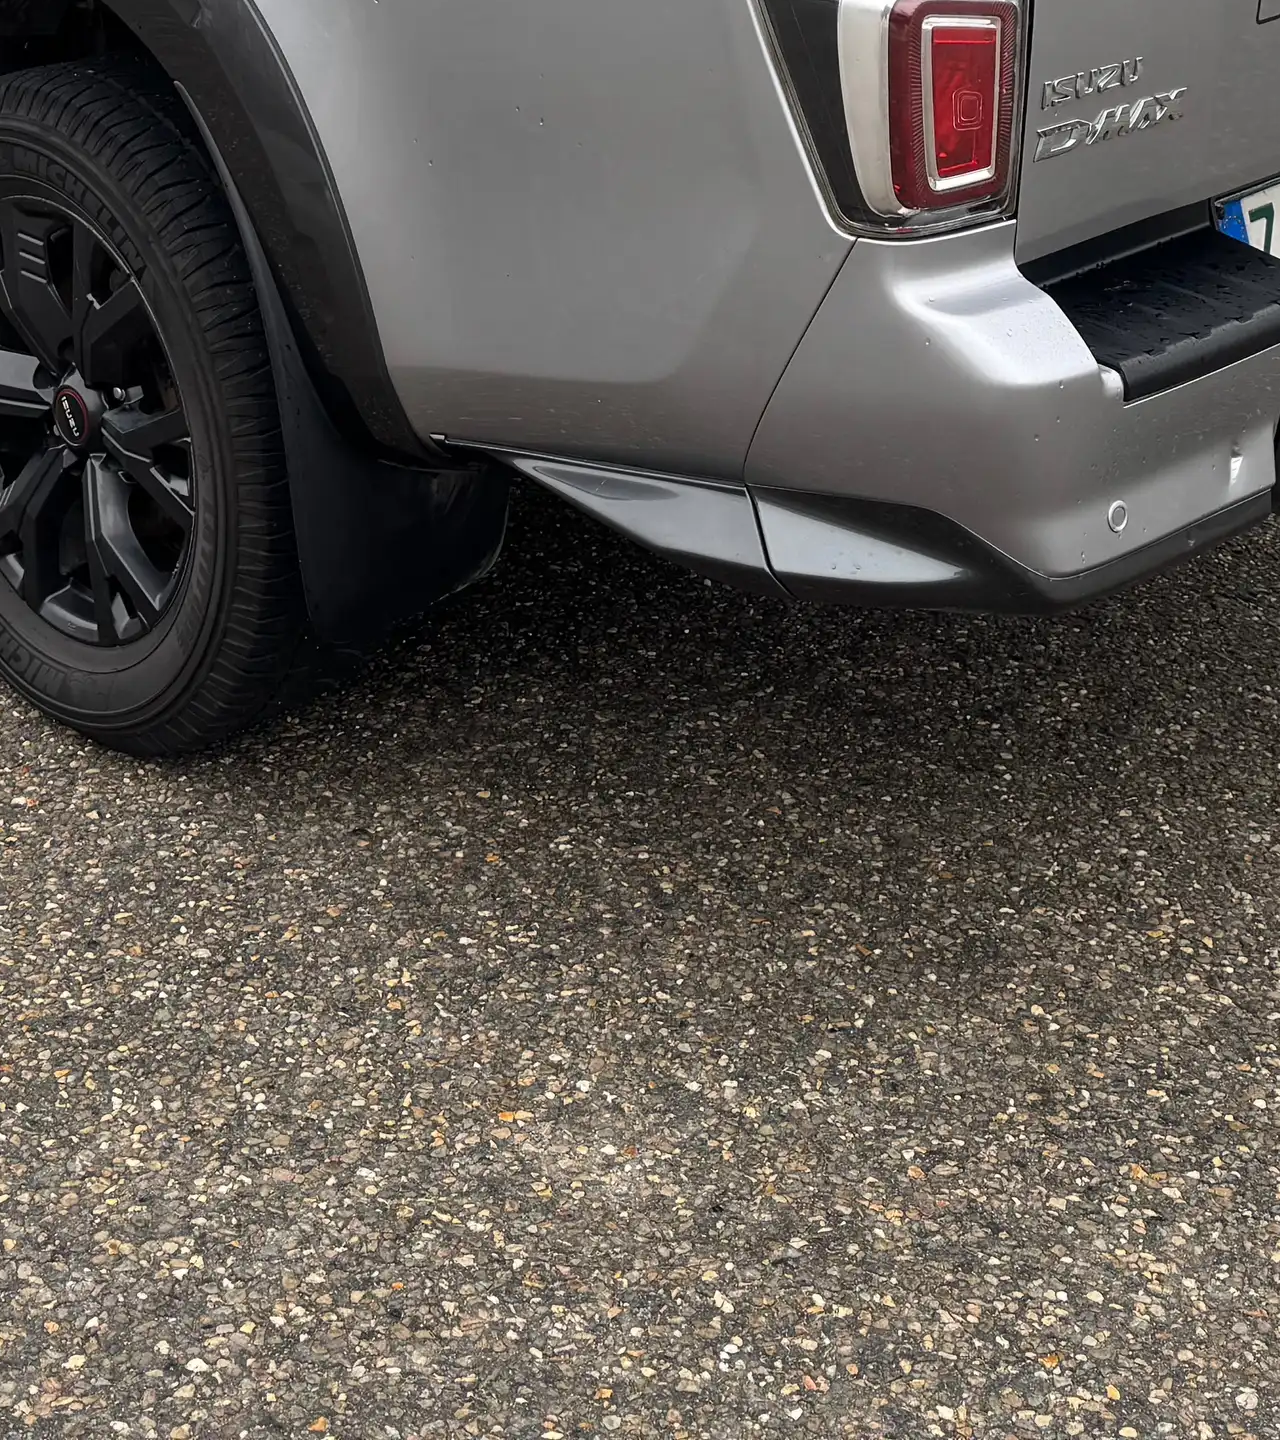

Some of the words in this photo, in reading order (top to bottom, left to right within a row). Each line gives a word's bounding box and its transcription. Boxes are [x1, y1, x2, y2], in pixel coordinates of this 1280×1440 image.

[1041, 56, 1144, 110] ISUZU
[12, 143, 148, 274] MICHELIN
[61, 395, 80, 437] ISUZU
